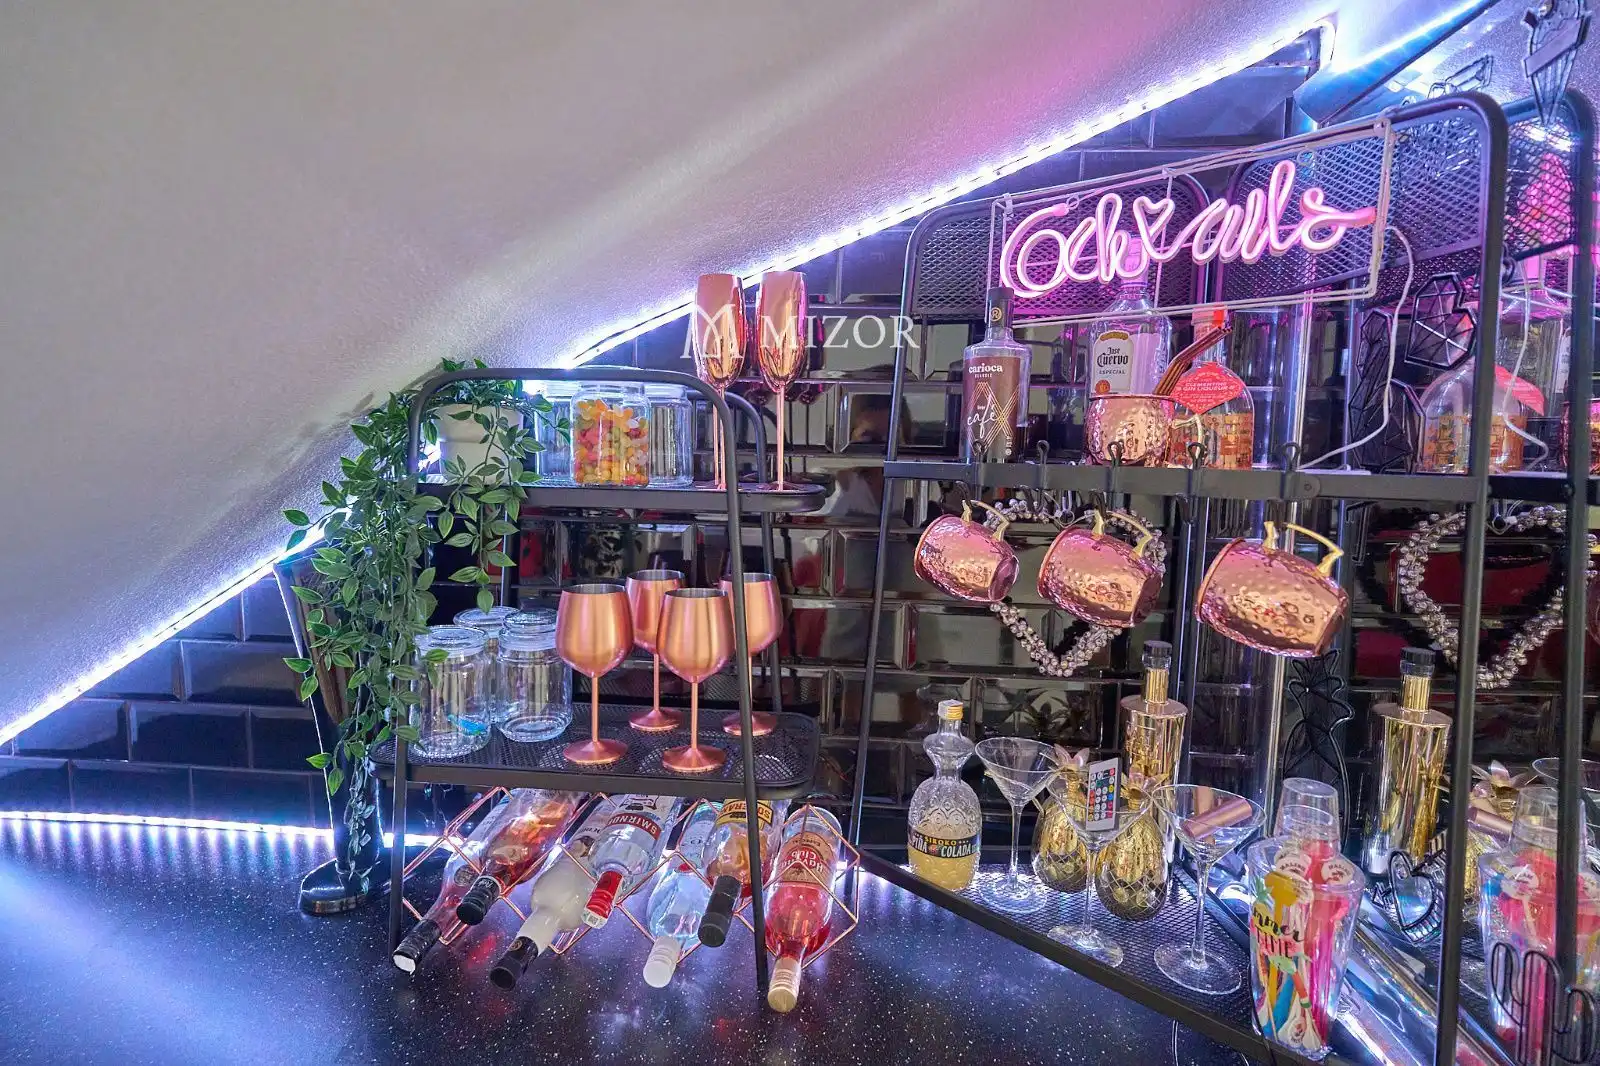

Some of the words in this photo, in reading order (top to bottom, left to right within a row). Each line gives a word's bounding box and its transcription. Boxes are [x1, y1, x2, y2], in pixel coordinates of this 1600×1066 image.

[1096, 352, 1129, 367] Cuervo
[968, 363, 1003, 373] carioca
[924, 836, 957, 846] SIROKO
[941, 843, 971, 857] COLADA
[1255, 923, 1293, 959] TIME
